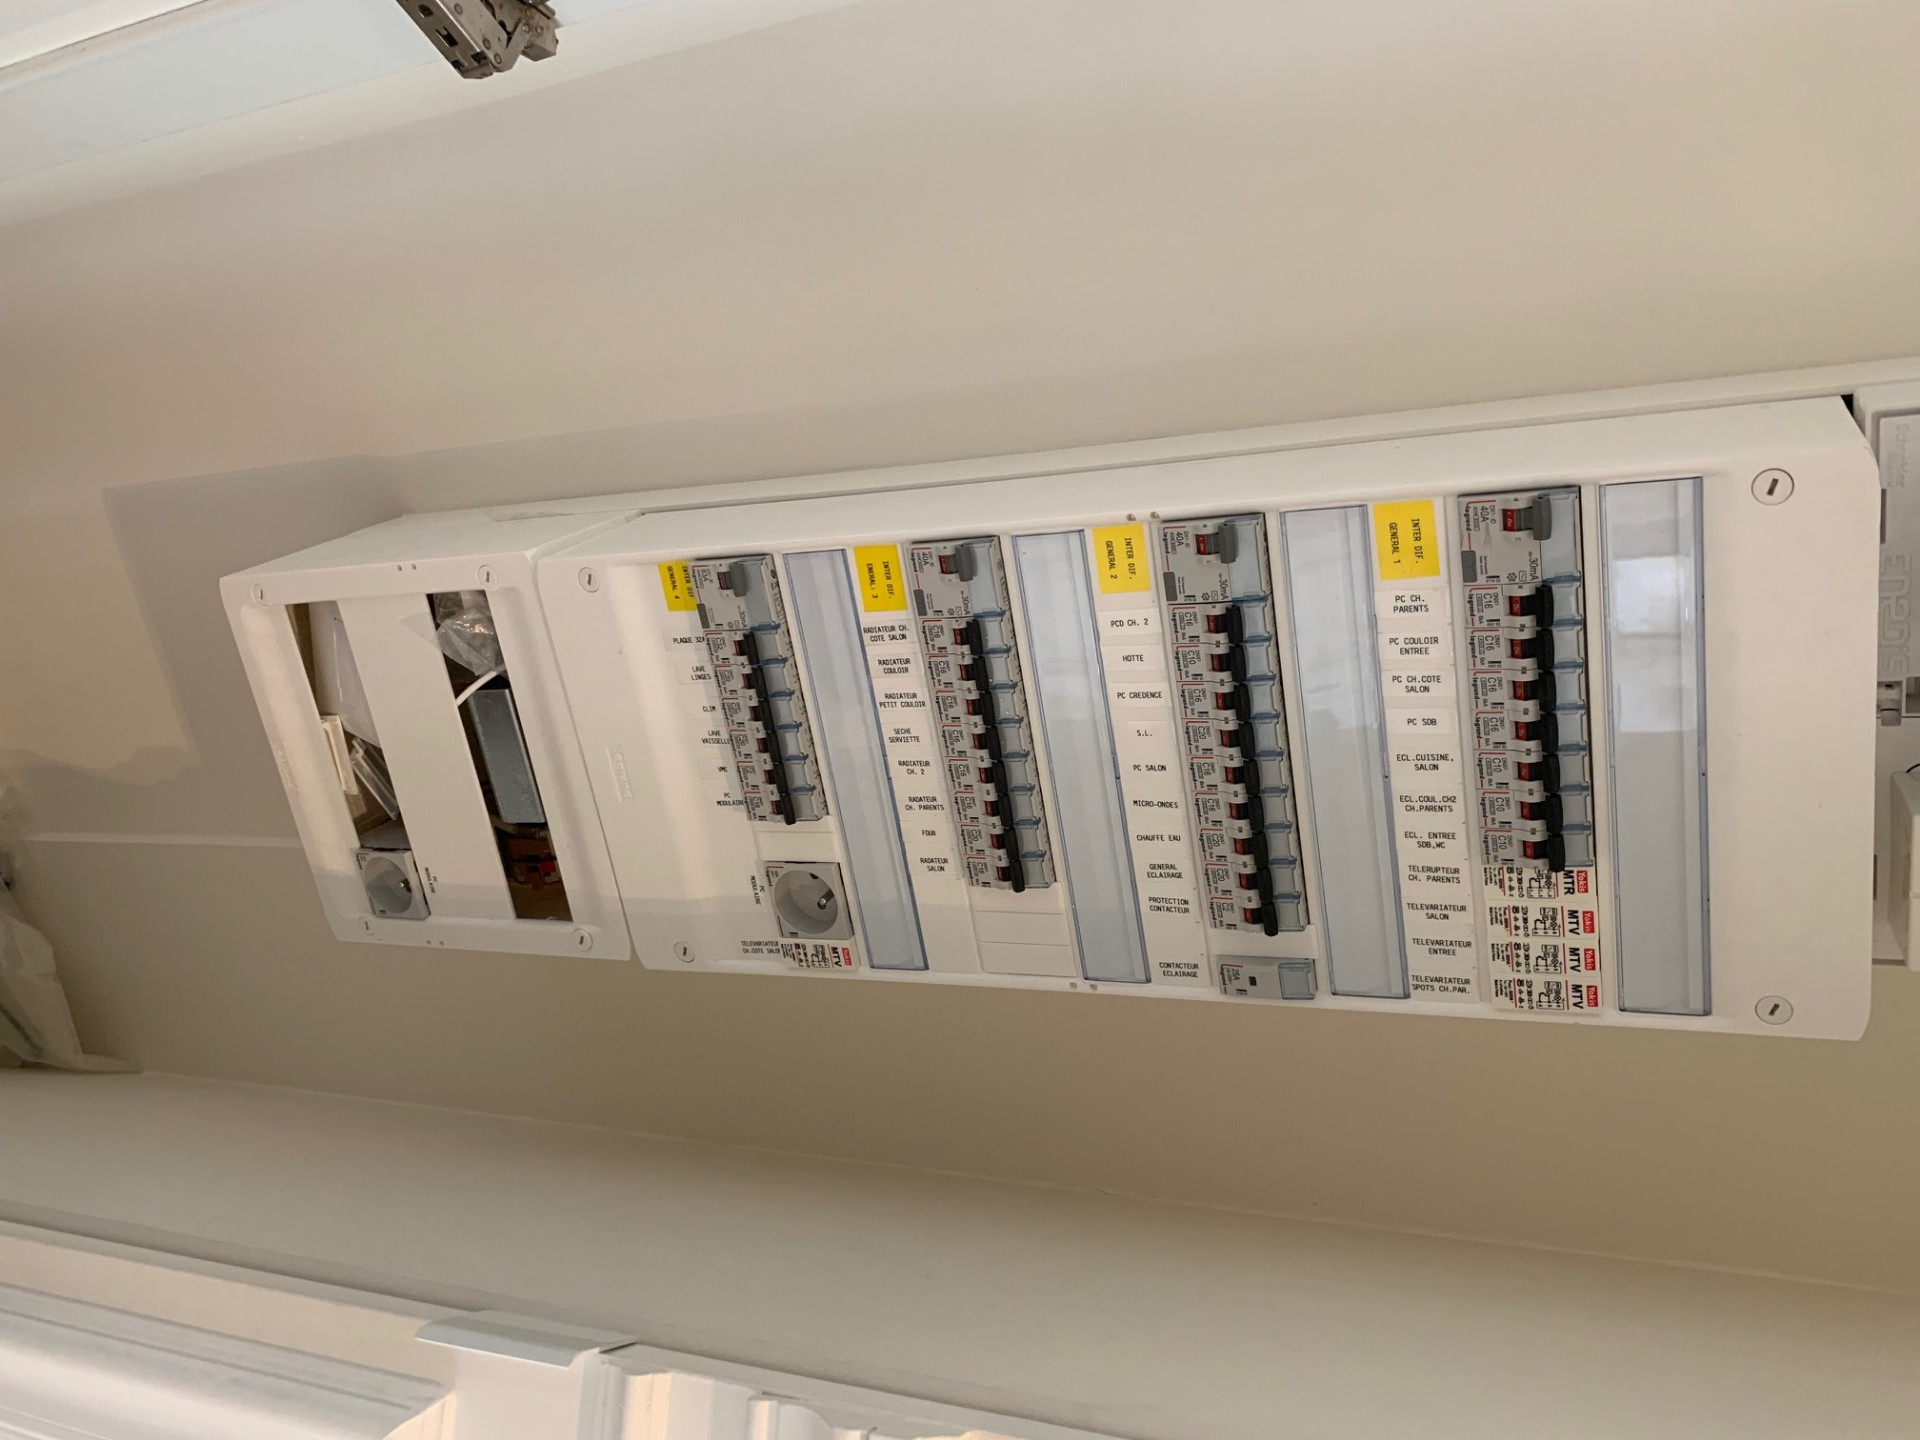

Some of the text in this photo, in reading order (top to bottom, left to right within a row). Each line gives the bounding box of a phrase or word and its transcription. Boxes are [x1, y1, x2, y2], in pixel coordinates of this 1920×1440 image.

[1464, 506, 1472, 531] legrand
[1480, 506, 1489, 522] 40A
[1176, 532, 1184, 546] 40A
[1389, 522, 1400, 555] GENERAL
[1411, 518, 1424, 564] INTER DIF.
[1106, 541, 1116, 571] GENERAL
[1124, 538, 1136, 580] INTER DIF.
[882, 561, 892, 584] INTER
[1529, 558, 1538, 581] 30mA
[1220, 579, 1229, 600] 30mA
[962, 596, 970, 615] 30mA
[1468, 594, 1476, 616] legrand
[1483, 593, 1492, 608] C16
[1394, 605, 1429, 613] PARENTS
[1184, 612, 1194, 626] C16
[863, 626, 895, 634] RADIATEUR
[1404, 637, 1439, 645] COULOIR
[1485, 635, 1494, 651] C16
[1188, 650, 1196, 665] C10
[938, 661, 947, 673] C16
[1472, 677, 1480, 699] legrand
[1488, 677, 1497, 692] C16
[1194, 689, 1202, 702] C16
[1474, 717, 1482, 739] legrand
[1490, 717, 1499, 732] C16
[1198, 726, 1206, 739] C20
[1397, 754, 1454, 762] ECL.CUISINE,
[1203, 762, 1213, 776] C16
[1477, 757, 1485, 779] legrand
[1493, 758, 1502, 773] C10
[1133, 801, 1178, 809] MICRO-ONDES
[1208, 798, 1217, 812] C16
[1400, 795, 1456, 803] ECL.COUL.CH2
[1496, 797, 1505, 811] C10
[1480, 797, 1488, 818] legrand
[1212, 833, 1221, 847] C20
[1428, 832, 1456, 840] ENTREE
[1498, 835, 1508, 849] C10
[1216, 868, 1226, 881] C20
[1408, 865, 1460, 875] TELERUPTEUR
[1426, 875, 1461, 884] PARENTS
[1563, 870, 1575, 895] MTR
[1578, 872, 1586, 892] Yokis
[1149, 897, 1189, 905] PROTECTION
[1222, 902, 1230, 912] C2
[1407, 903, 1467, 912] TELEVARIATEUR
[1426, 912, 1449, 920] SALON
[1568, 910, 1580, 935] MTV
[1584, 912, 1593, 932] Yokis
[1412, 938, 1472, 948] TELEVARIATEUR
[831, 947, 842, 967] MTV
[1428, 948, 1456, 956] ENTREE
[1585, 949, 1595, 969] Yokis
[1160, 962, 1199, 970] CONTACTEUR
[1569, 948, 1581, 972] MTV
[1232, 969, 1240, 980] 25A
[1411, 975, 1470, 985] TELEVARIATEUR
[1412, 984, 1470, 994] SPOTS CH.PAR.
[1588, 986, 1597, 1006] Yokis
[1571, 984, 1584, 1009] MTV
